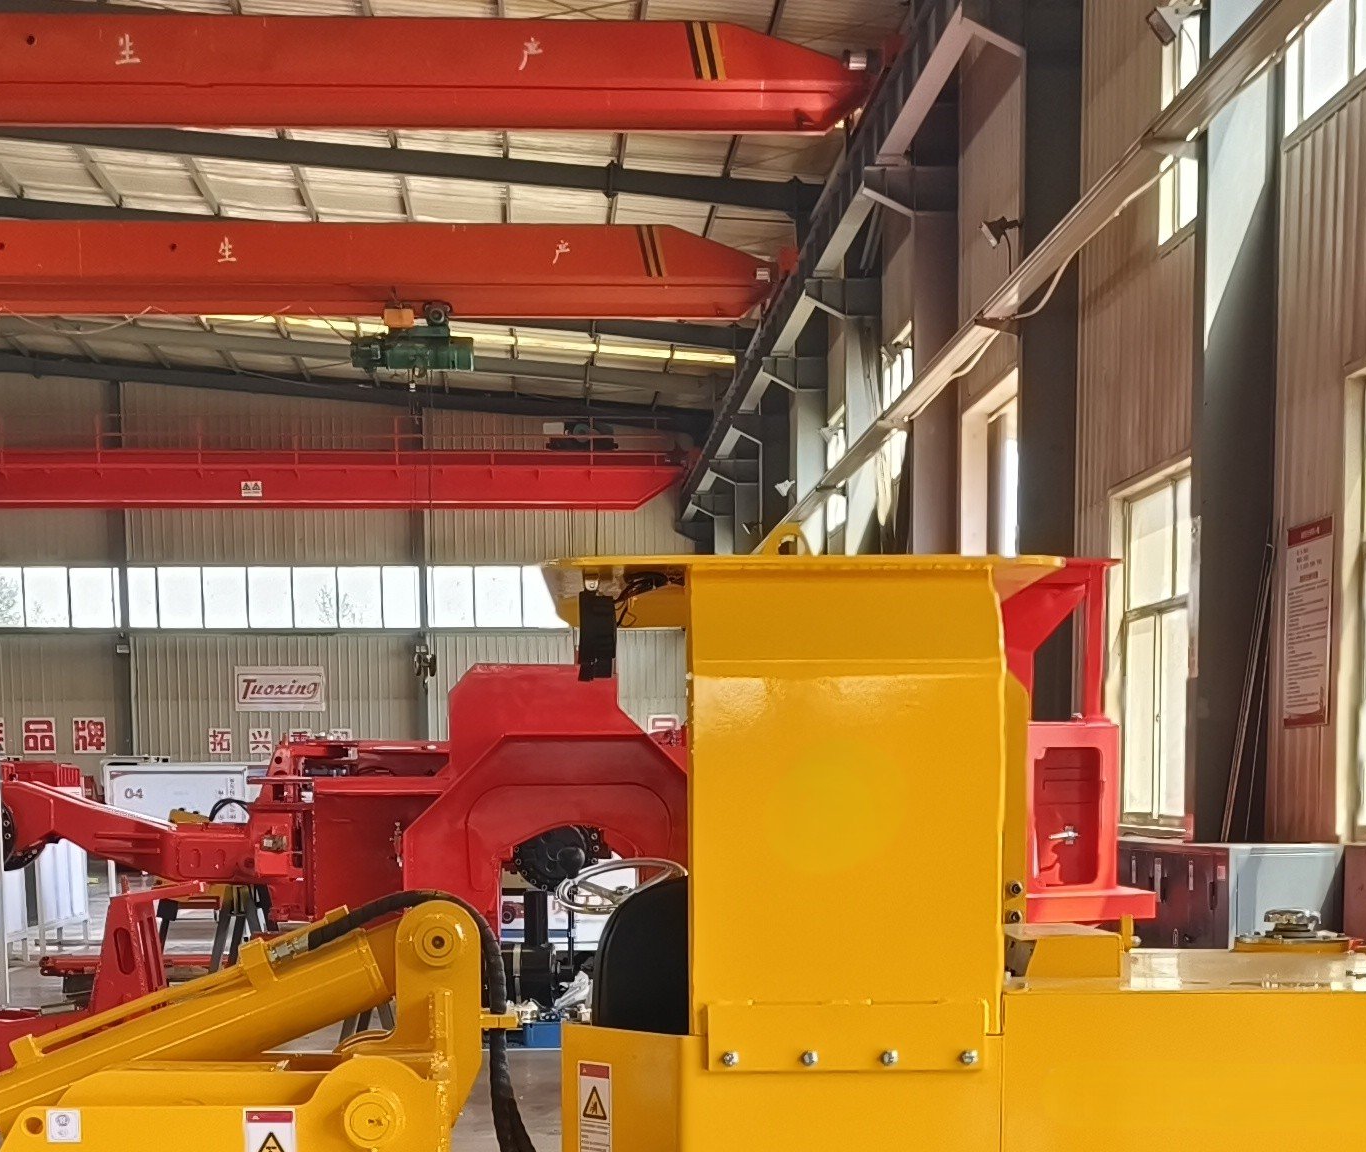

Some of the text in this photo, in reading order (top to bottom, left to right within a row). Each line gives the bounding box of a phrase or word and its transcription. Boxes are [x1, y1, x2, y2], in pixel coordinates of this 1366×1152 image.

[114, 33, 141, 65] 生
[518, 36, 543, 70] 产
[217, 236, 237, 263] 生
[552, 239, 571, 265] 产
[242, 678, 320, 701] Tuoxing
[124, 787, 144, 799] 04
